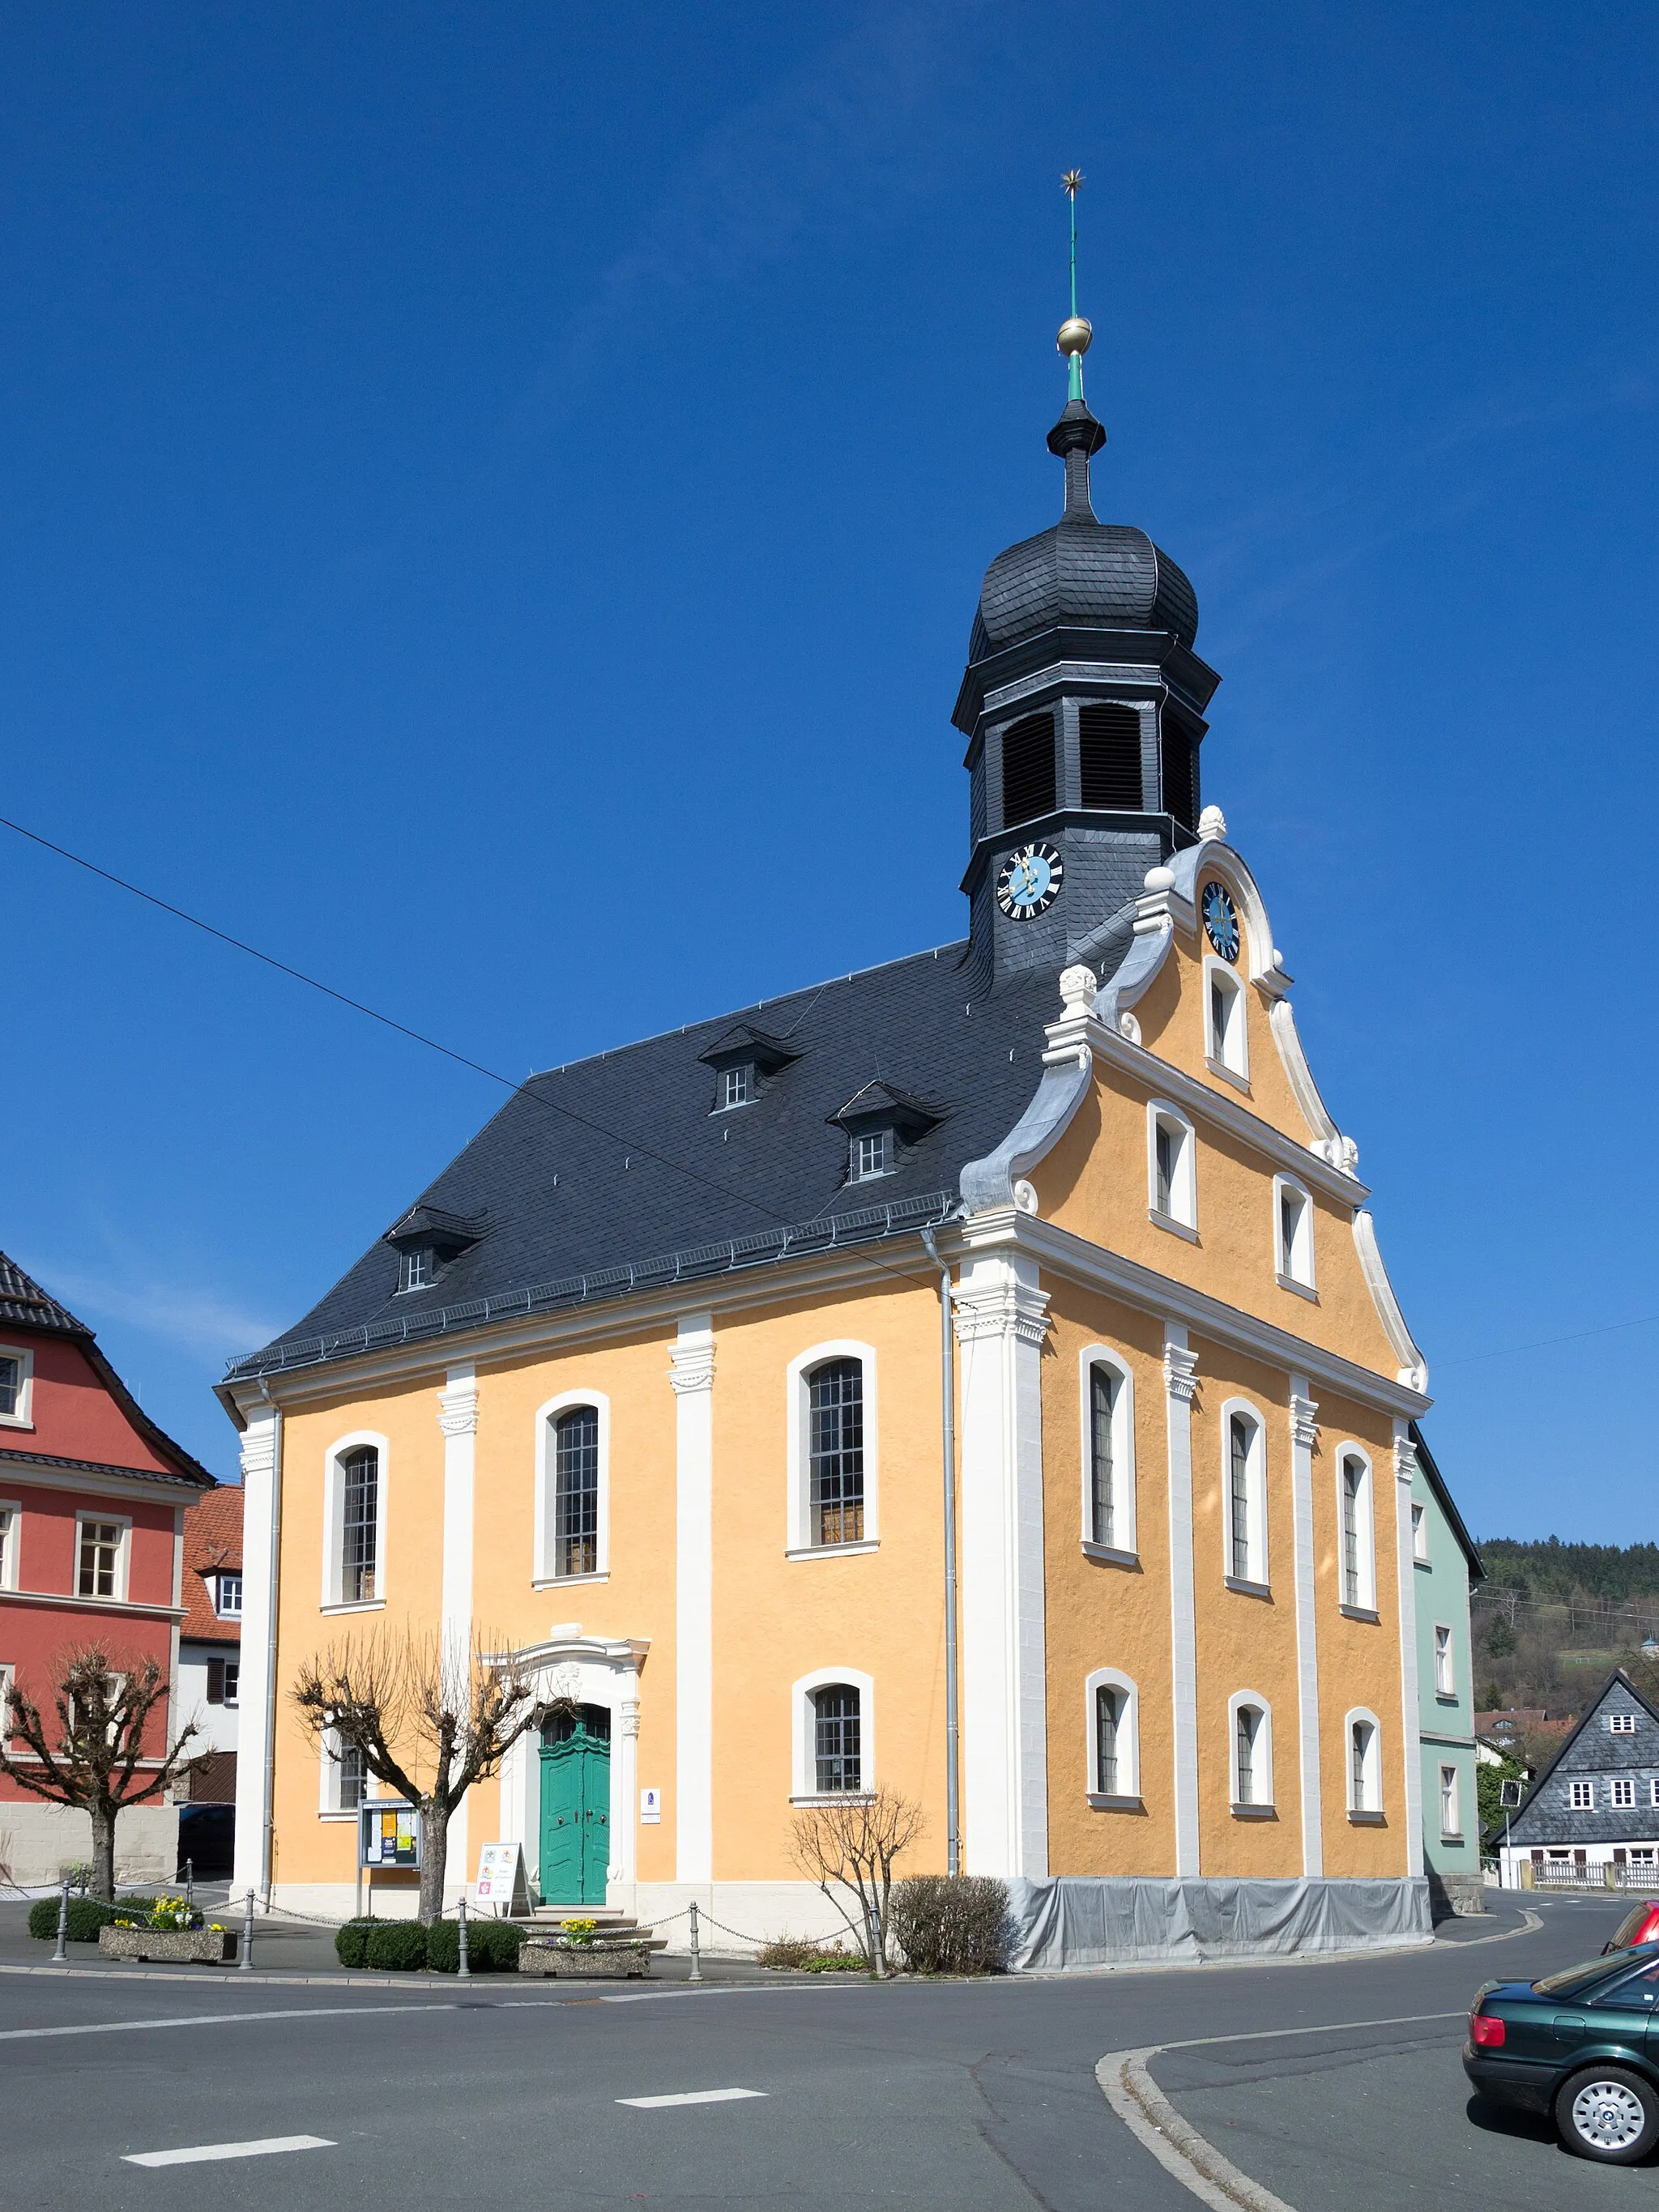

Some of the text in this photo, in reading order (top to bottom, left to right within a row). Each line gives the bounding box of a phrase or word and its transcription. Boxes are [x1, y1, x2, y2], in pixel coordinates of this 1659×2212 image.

[1039, 844, 1047, 856] I
[1047, 851, 1059, 863] II
[1000, 869, 1013, 879] X
[1051, 865, 1062, 876] III
[1040, 897, 1050, 910] V
